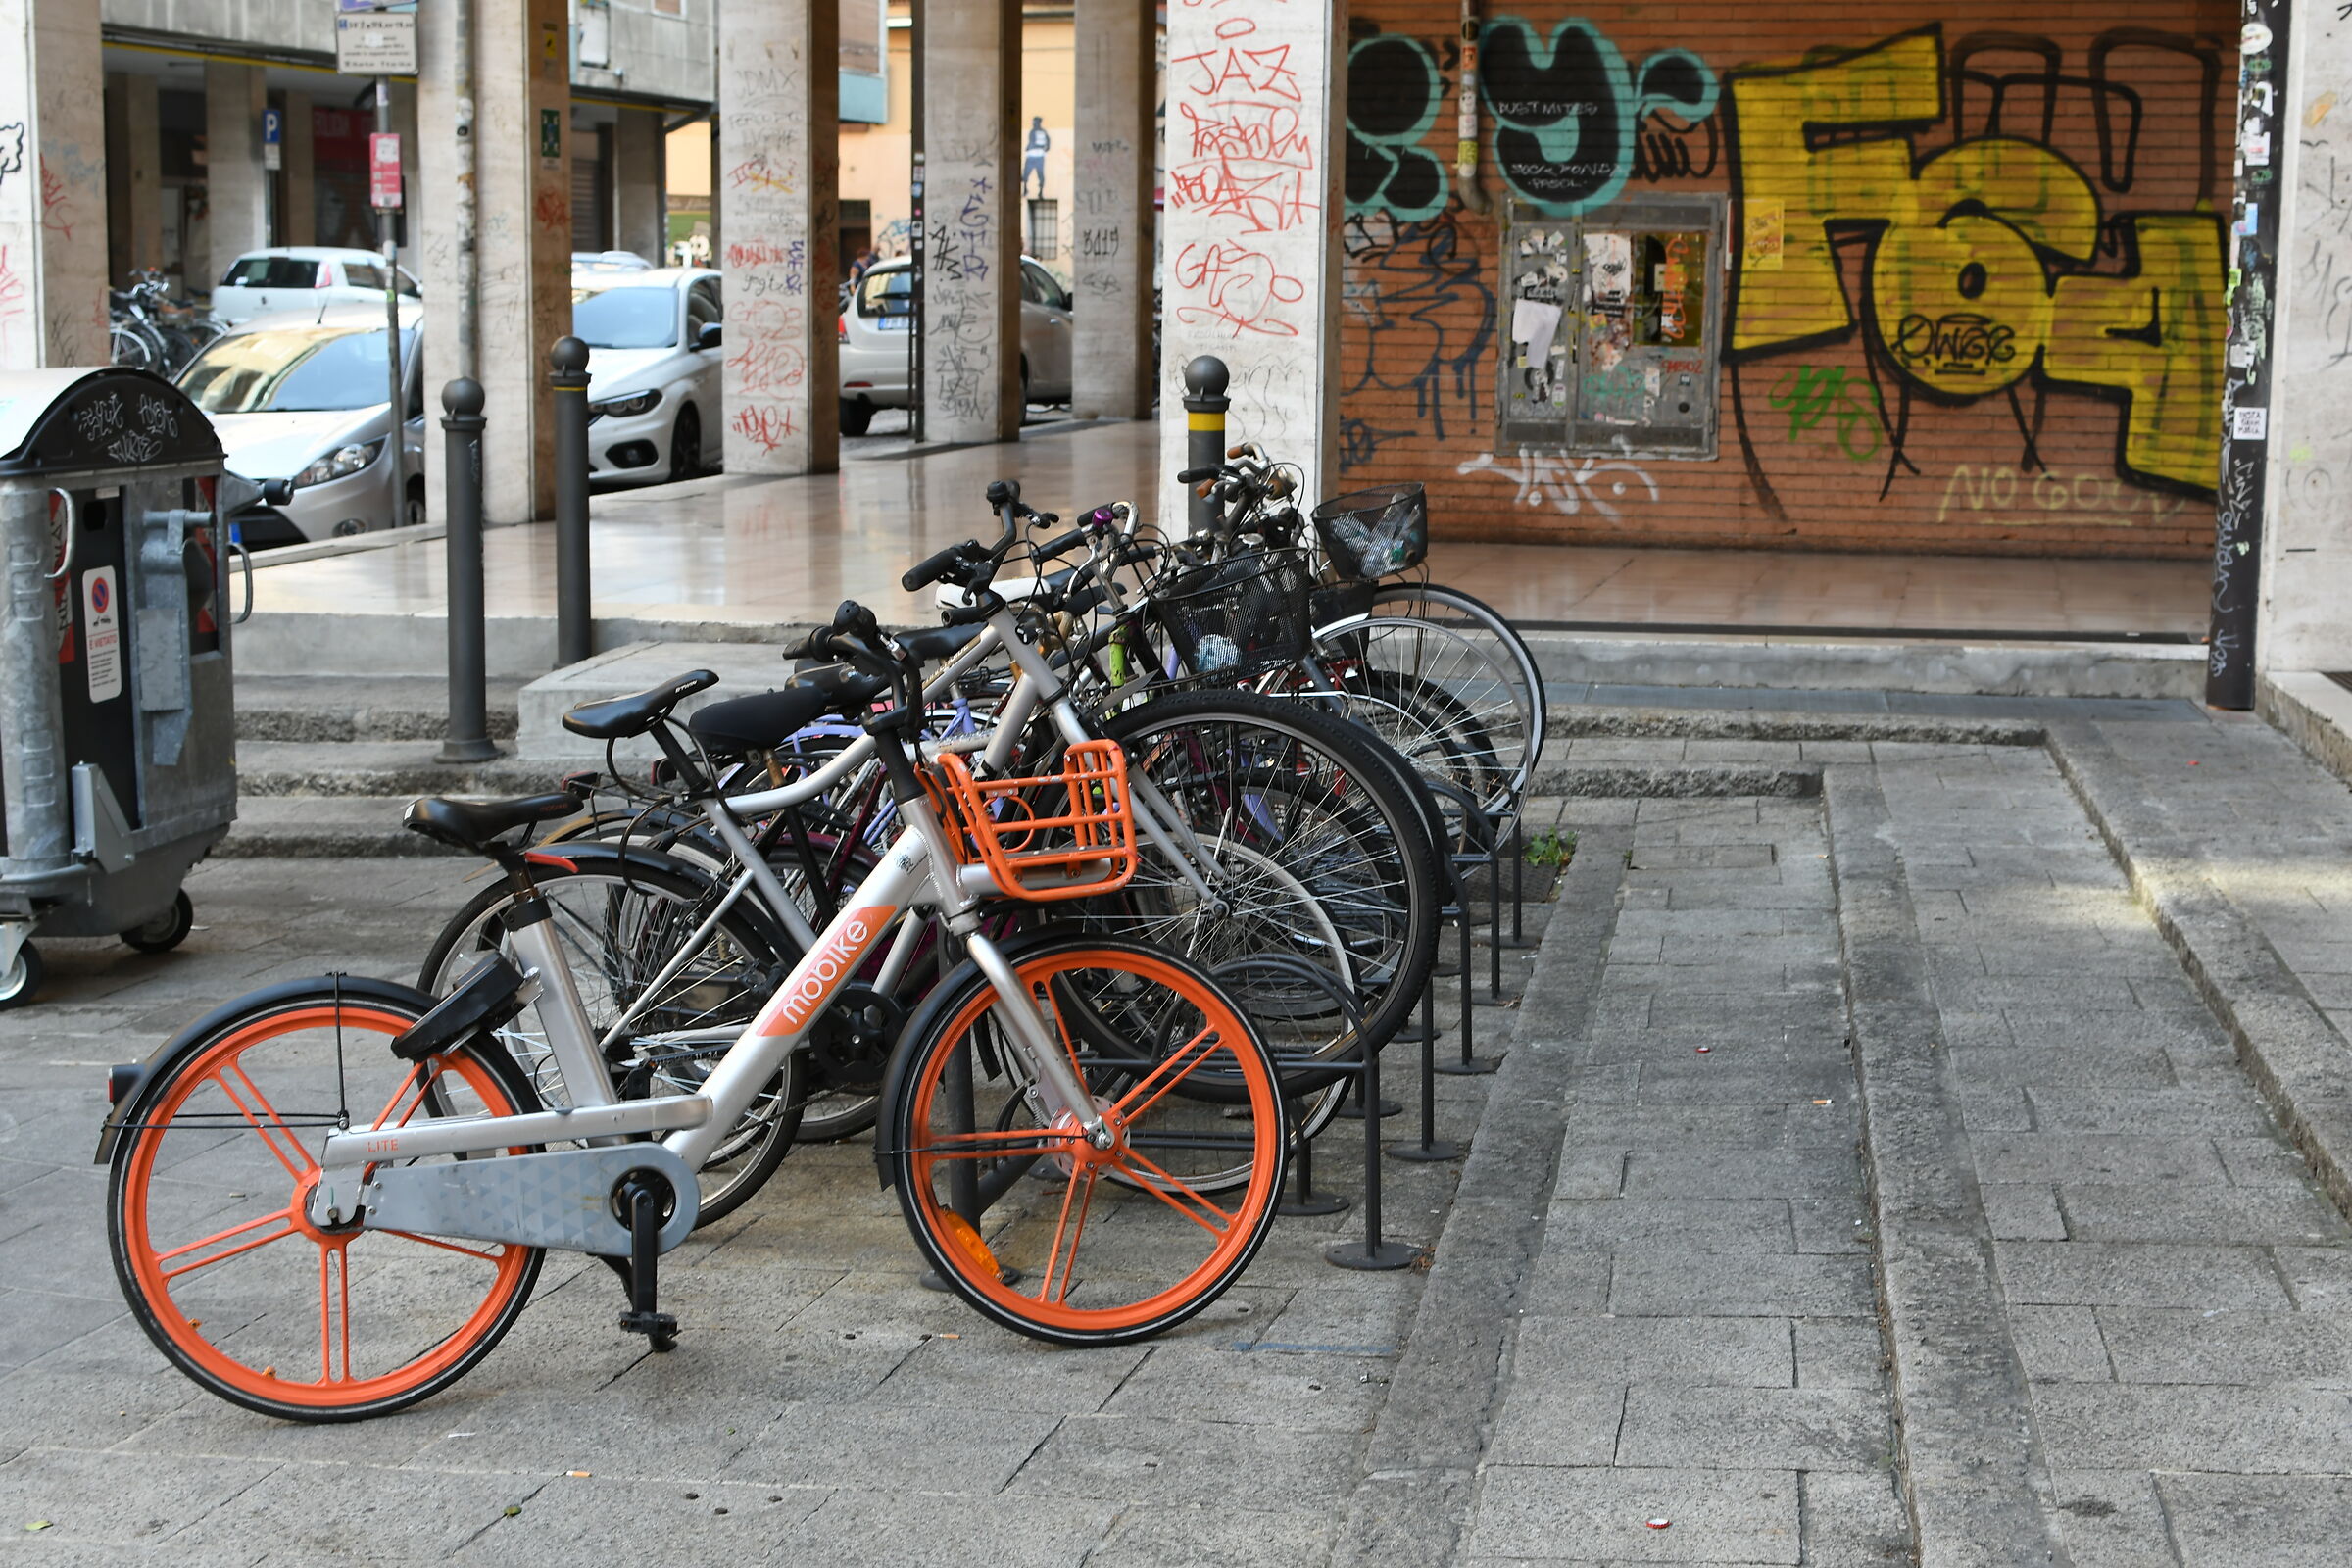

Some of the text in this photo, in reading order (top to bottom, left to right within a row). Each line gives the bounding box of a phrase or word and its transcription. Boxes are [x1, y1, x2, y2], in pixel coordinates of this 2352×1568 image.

[266, 113, 278, 141] P
[1936, 465, 2019, 523] NO
[782, 920, 869, 1025] mobike
[368, 1138, 399, 1153] LITE
